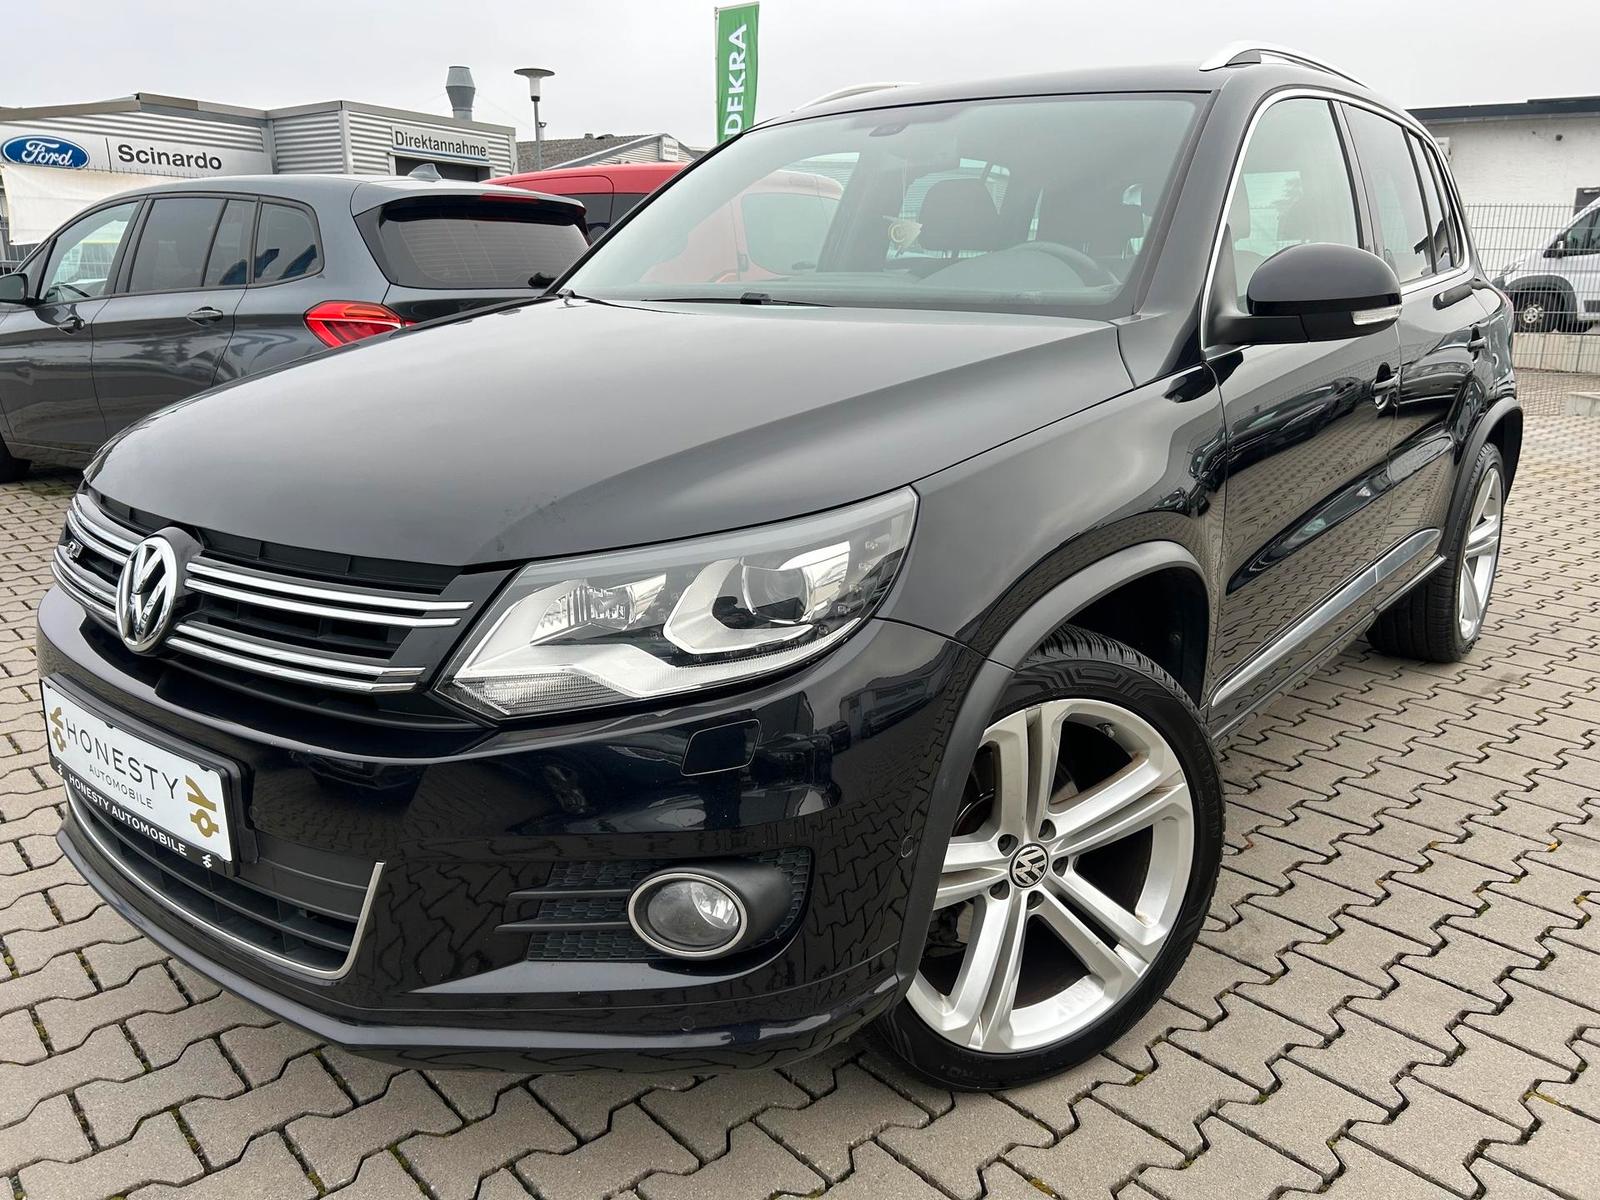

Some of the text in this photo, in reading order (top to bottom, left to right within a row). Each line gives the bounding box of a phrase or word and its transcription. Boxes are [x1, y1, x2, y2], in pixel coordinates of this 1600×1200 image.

[724, 23, 747, 136] DEKRA
[22, 140, 73, 166] Ford
[118, 143, 222, 170] Scinardo
[395, 131, 487, 157] Direktannahme
[65, 718, 179, 800] HONESTY
[89, 764, 154, 810] AUTOMOBILE
[69, 773, 188, 857] HONESTY AUTOMOBILE
